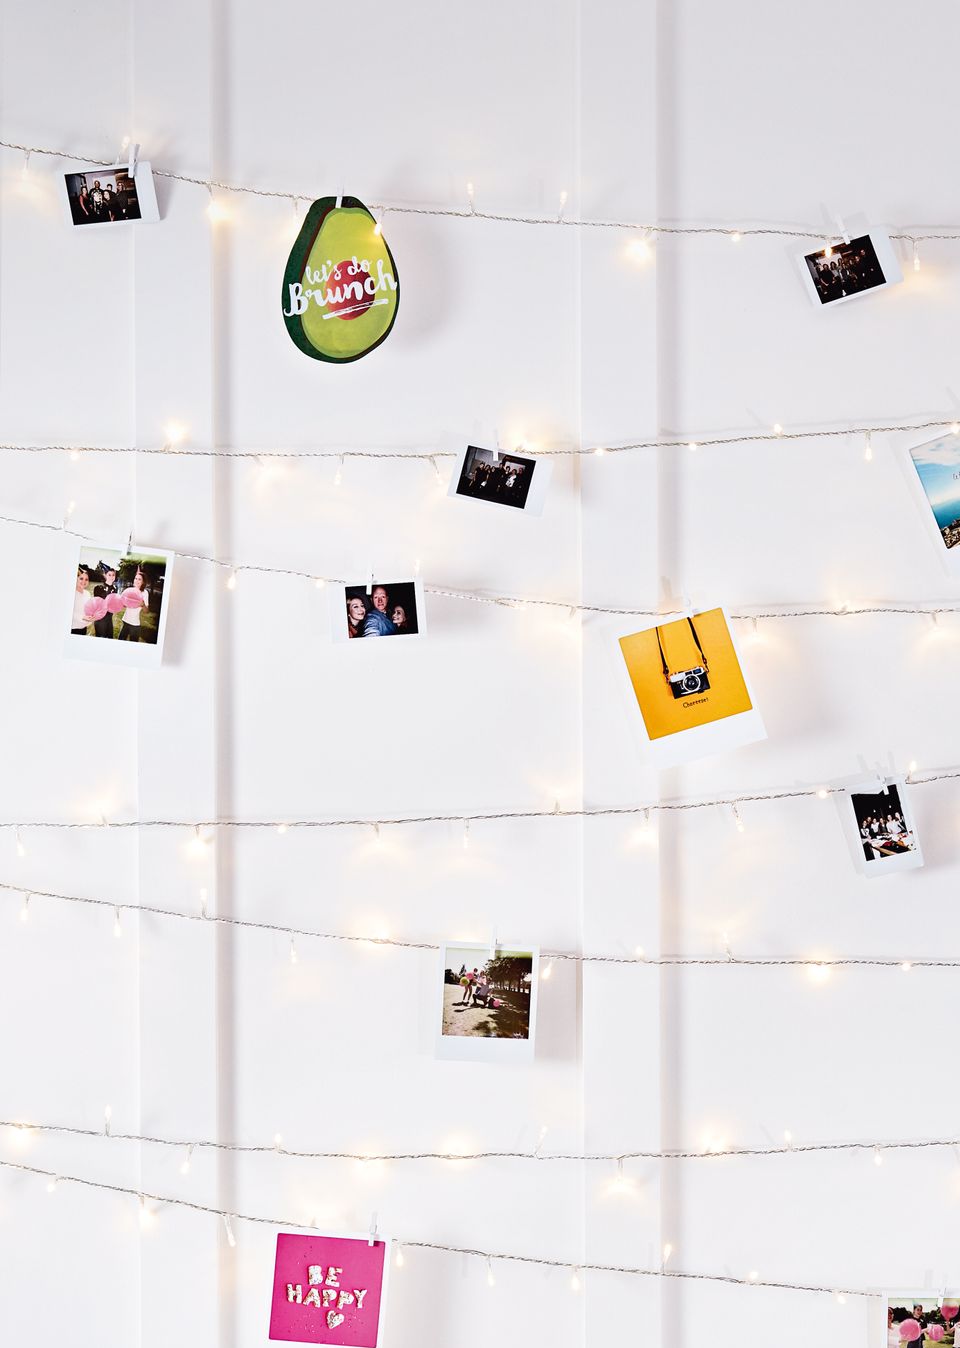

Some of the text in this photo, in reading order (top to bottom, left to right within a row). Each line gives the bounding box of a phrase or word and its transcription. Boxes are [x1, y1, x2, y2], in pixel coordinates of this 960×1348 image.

[305, 256, 373, 285] let's do
[283, 259, 398, 318] Brunch
[308, 1264, 343, 1287] BE
[287, 1283, 367, 1310] HAPPY
